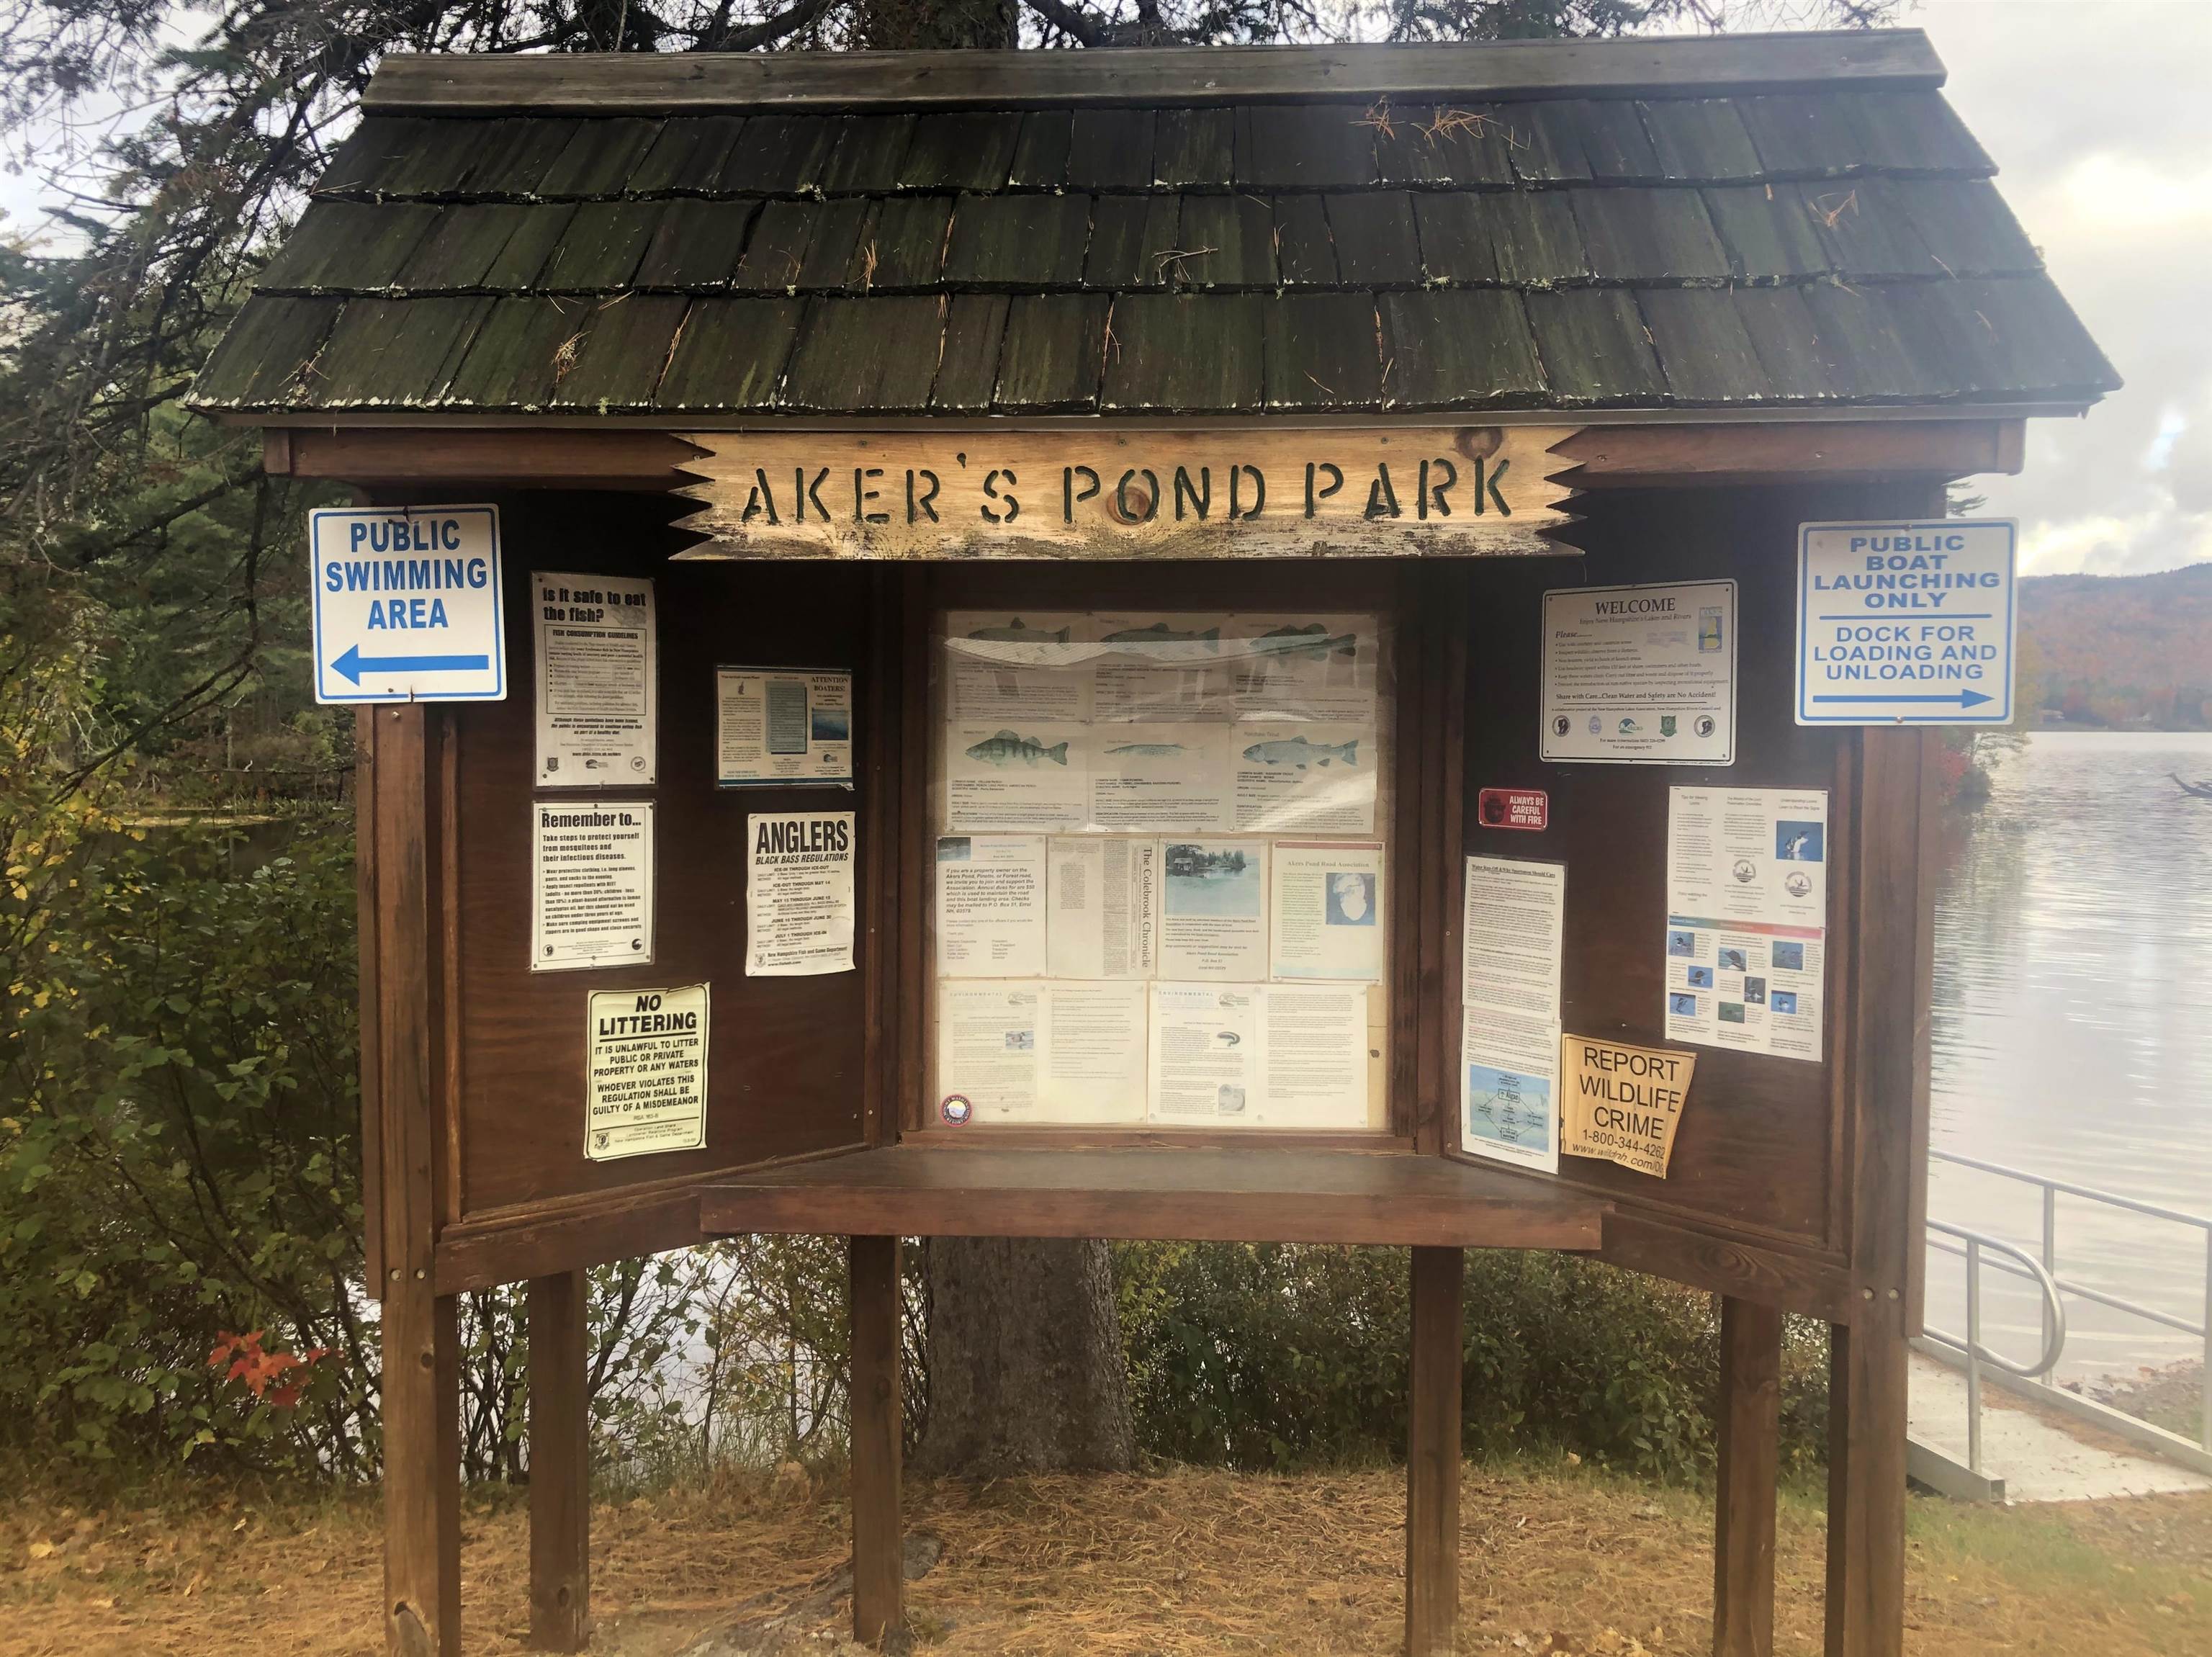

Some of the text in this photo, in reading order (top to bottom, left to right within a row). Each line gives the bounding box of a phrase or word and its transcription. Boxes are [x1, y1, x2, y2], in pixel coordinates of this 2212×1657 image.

[742, 453, 1511, 525] AKER'S POND PARK
[351, 520, 460, 552] PUBLIC
[1851, 535, 1964, 552] PUBLIC
[1866, 555, 1948, 570] BOAT
[326, 558, 486, 592] SWIMMING
[1815, 572, 2000, 590] LAUNCHING
[543, 588, 646, 606] Is it safe to eat
[1864, 593, 1948, 608] ONLY
[368, 598, 449, 629] AREA
[1596, 598, 1676, 614] WELCOME
[544, 607, 604, 622] the fish?
[1836, 626, 1974, 642] DOCK FOR
[1815, 645, 1997, 661] LOADING AND
[1827, 664, 1983, 680] UNLOADING
[1509, 796, 1544, 806] ALWAYS BE
[1512, 806, 1540, 814] CAREFUL
[542, 812, 641, 827] Remember to...
[1510, 814, 1542, 825] WITH FIRE
[756, 820, 848, 854] ANGLERS
[756, 856, 779, 865] BLACK
[801, 853, 848, 862] REGULATIONS
[1142, 847, 1152, 968] The Colebrook Chronicle
[636, 995, 661, 1012] NO
[599, 1012, 696, 1036] LITTERING
[616, 1042, 657, 1053] UNLAWFUL
[673, 1038, 698, 1048] LITTER
[610, 1054, 637, 1064] PUBLIC
[653, 1050, 684, 1061] PRIVATE
[1584, 1047, 1680, 1081] REPORT
[594, 1066, 634, 1077] PROPERTY
[650, 1062, 665, 1071] ANY
[668, 1059, 698, 1069] WATERS
[598, 1082, 636, 1092] WHOEVER
[639, 1077, 675, 1088] VIOLATES
[602, 1091, 650, 1103] REGULATION
[654, 1087, 677, 1097] SHALL
[1579, 1074, 1681, 1113] WILDLIFE
[593, 1105, 620, 1115] GUILTY
[643, 1096, 698, 1109] MISDEMEANOR
[1594, 1107, 1664, 1140] CRIME
